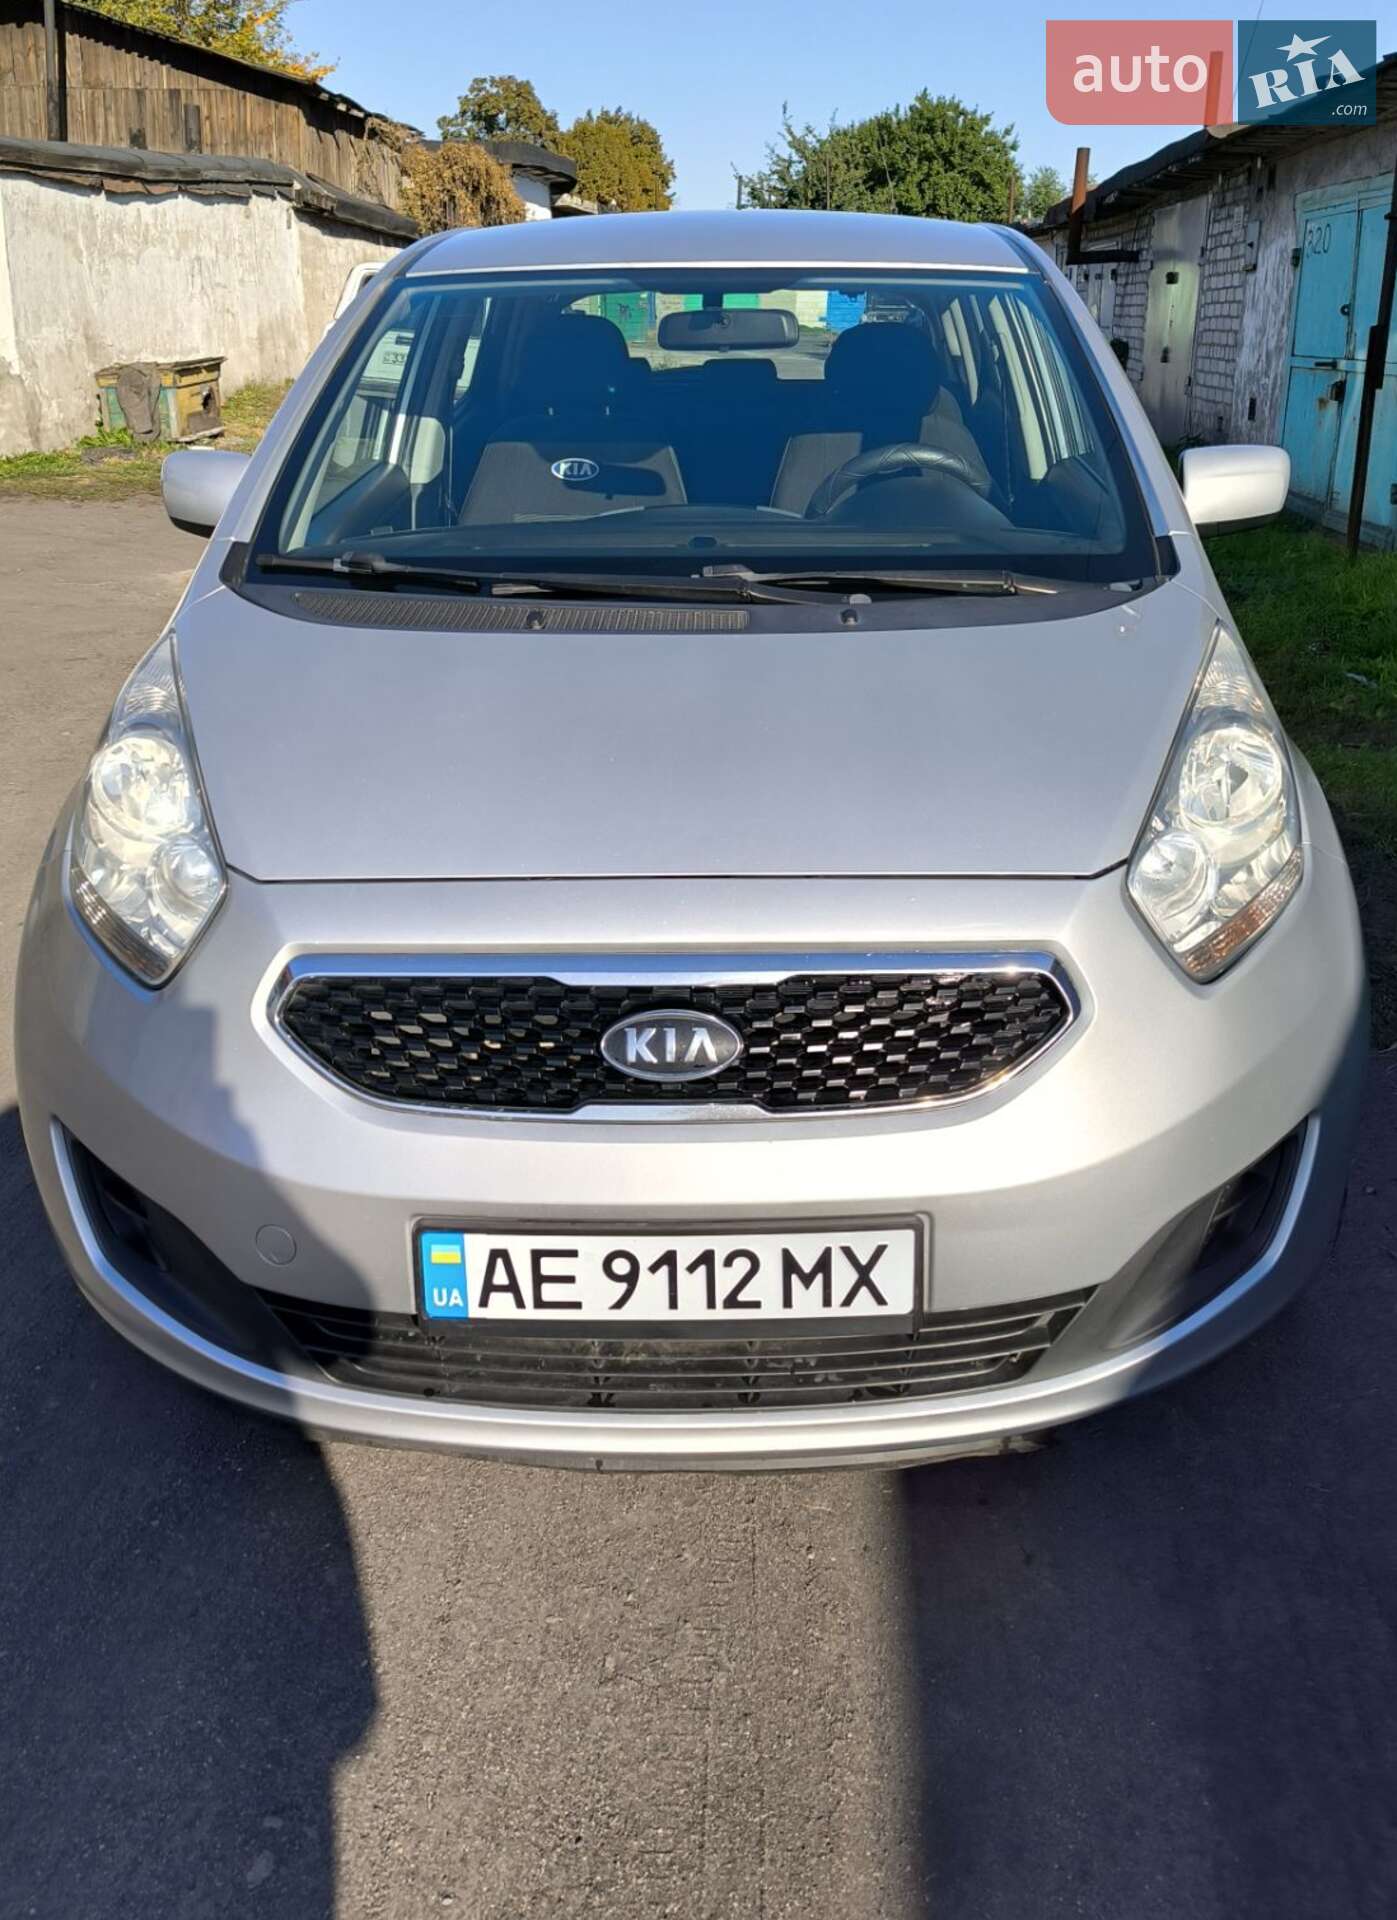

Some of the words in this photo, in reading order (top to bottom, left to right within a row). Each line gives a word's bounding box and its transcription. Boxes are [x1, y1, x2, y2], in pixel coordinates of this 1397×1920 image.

[559, 462, 593, 476] KIA
[624, 1026, 718, 1064] KIA
[478, 1248, 583, 1310] AE
[602, 1249, 762, 1310] 9112
[782, 1243, 889, 1308] MX
[432, 1286, 464, 1308] UA
